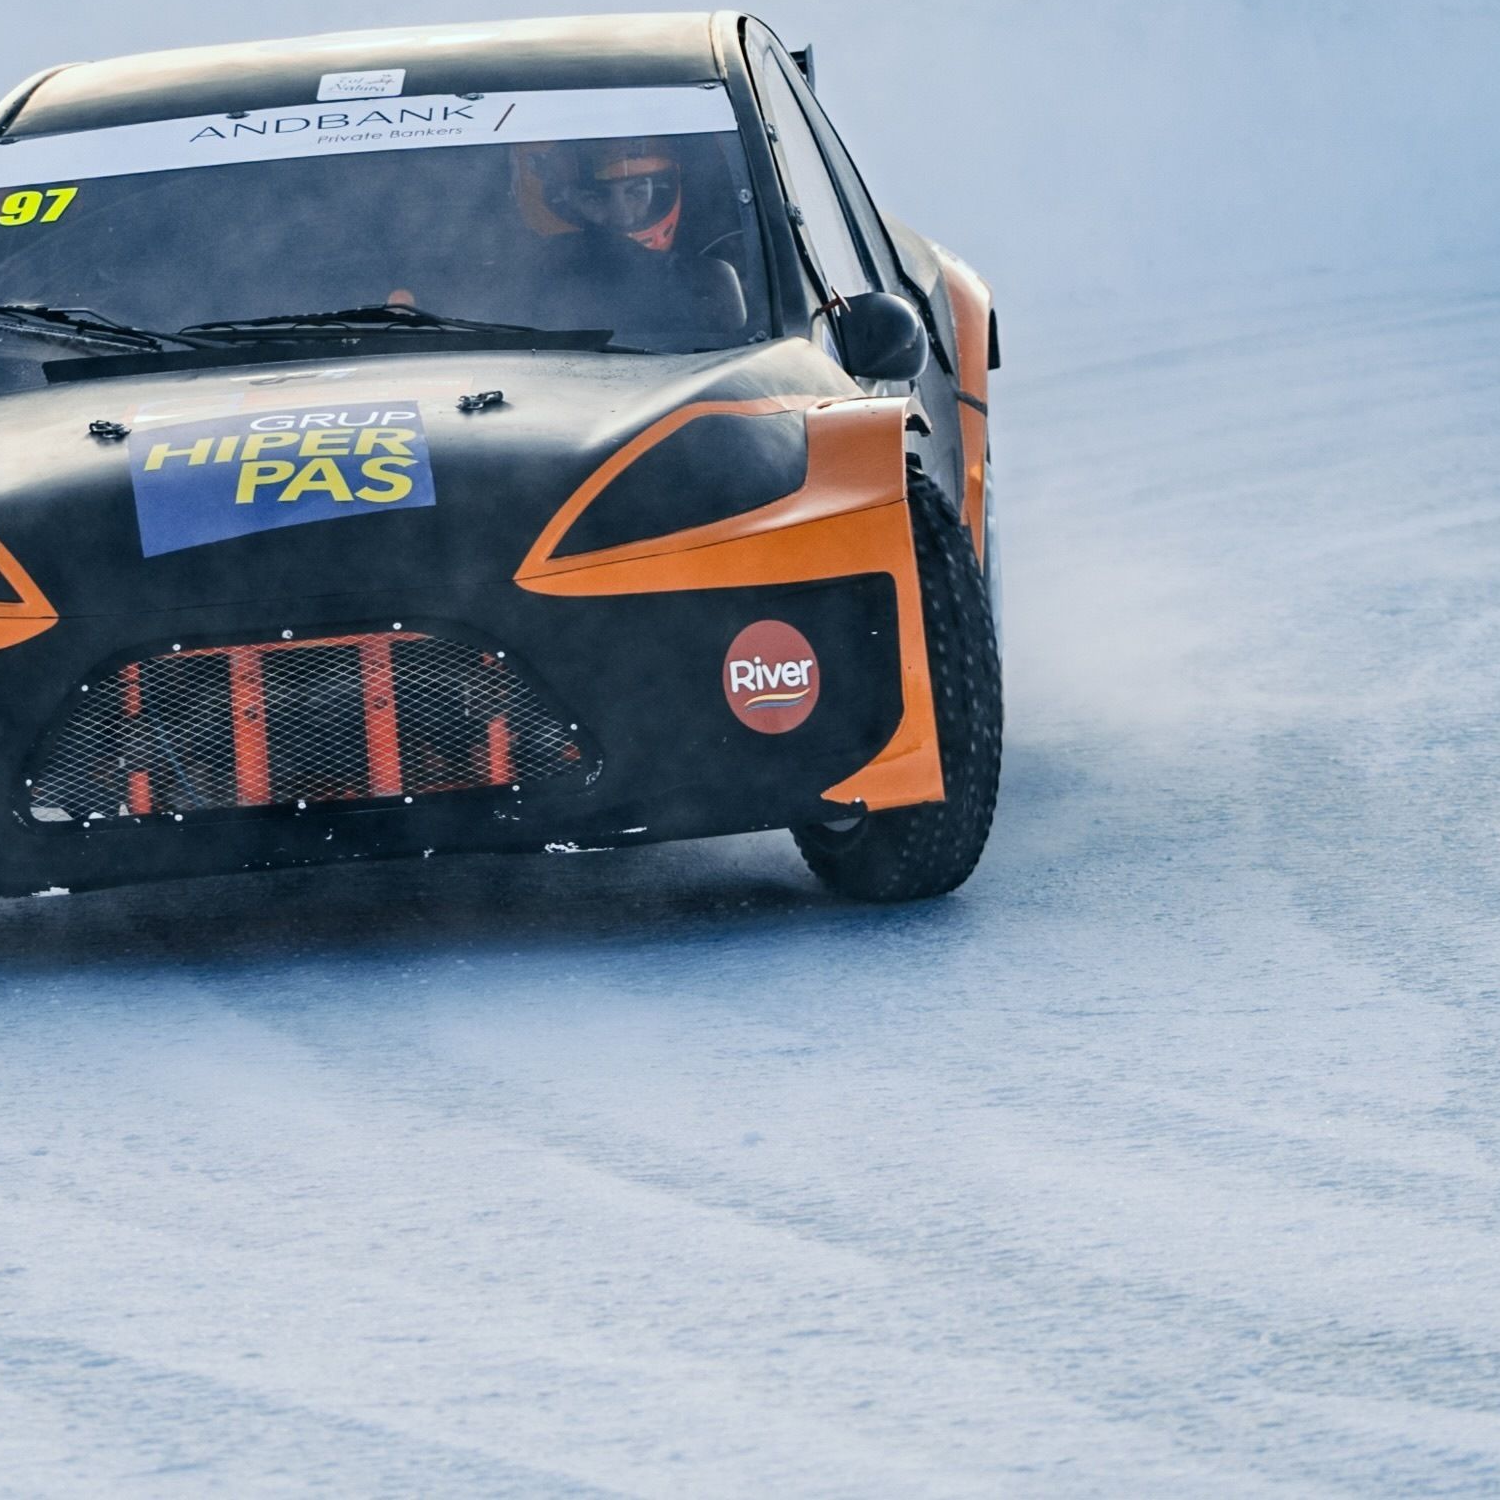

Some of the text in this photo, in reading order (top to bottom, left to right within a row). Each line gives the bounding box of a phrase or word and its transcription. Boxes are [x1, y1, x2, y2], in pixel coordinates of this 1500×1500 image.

[188, 105, 475, 143] ANDBANK
[316, 125, 464, 145] Private Bankers
[249, 410, 417, 432] GRUP
[143, 427, 418, 472] HIPER
[234, 456, 420, 505] PAS
[729, 654, 814, 695] River
